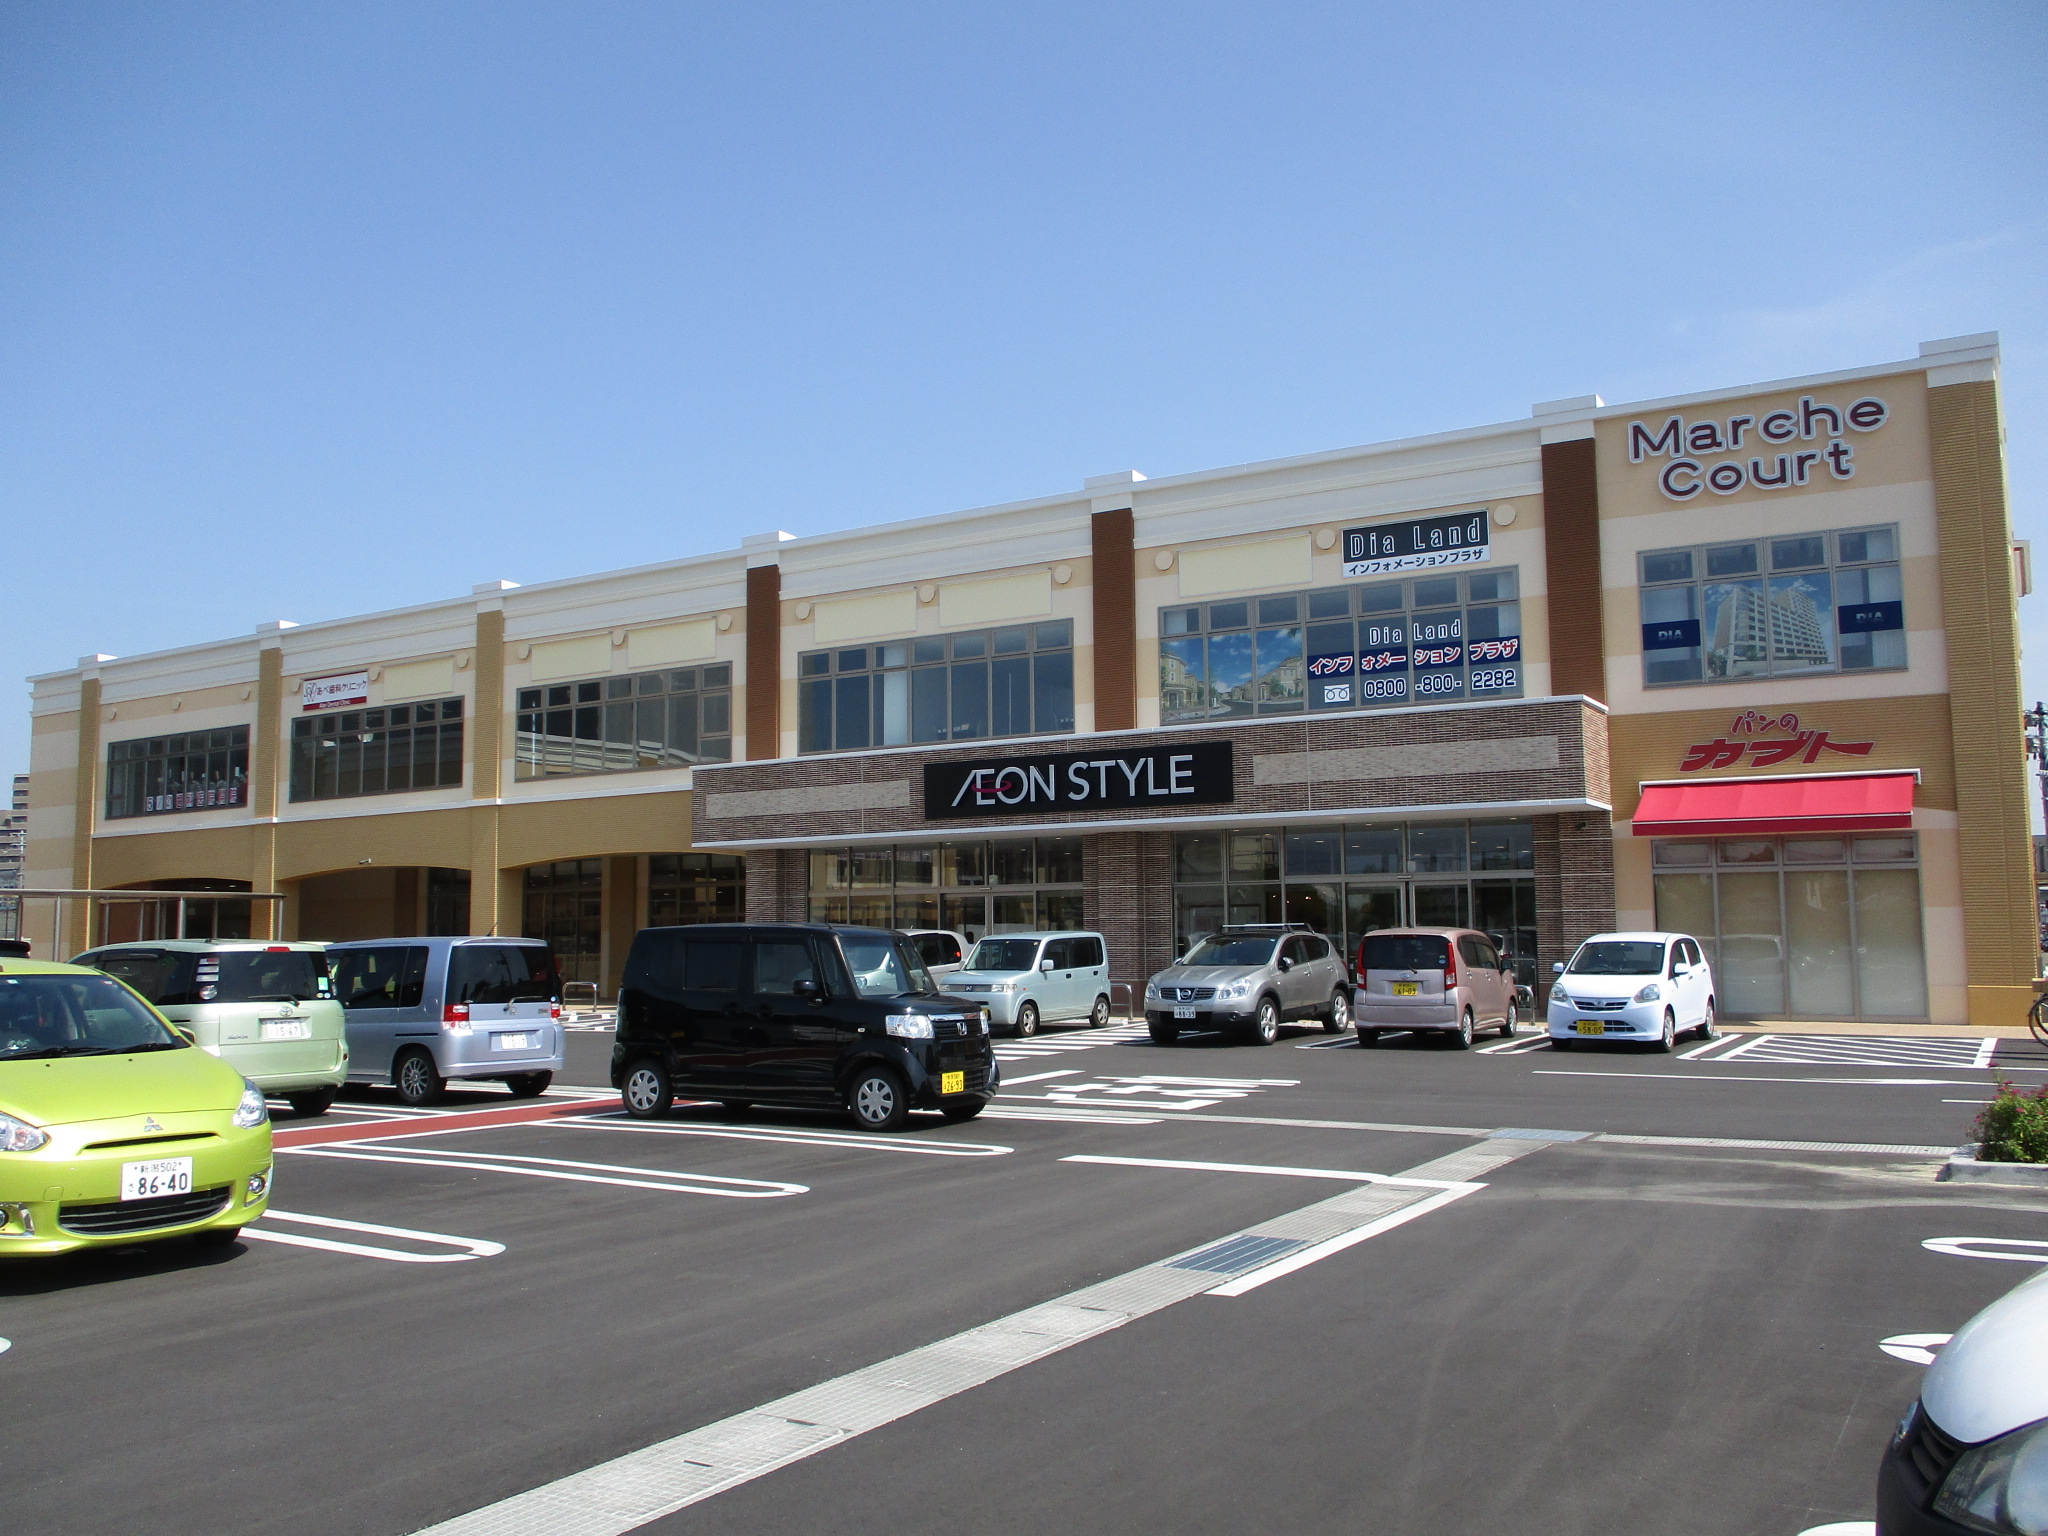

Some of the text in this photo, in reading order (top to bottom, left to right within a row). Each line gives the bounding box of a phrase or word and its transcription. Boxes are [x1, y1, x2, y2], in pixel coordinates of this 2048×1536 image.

[1628, 396, 1889, 463] Marche
[1658, 439, 1854, 501] Court
[1350, 517, 1481, 558] Dia Land
[1349, 548, 1484, 575] インフォメーションプラザ
[1369, 618, 1461, 645] Dia Land
[1657, 629, 1683, 641] DIA
[1730, 710, 1800, 734] パンの
[1679, 730, 1876, 773] カブト
[1067, 754, 1195, 801] STYLE
[138, 1172, 188, 1196] 86-40
